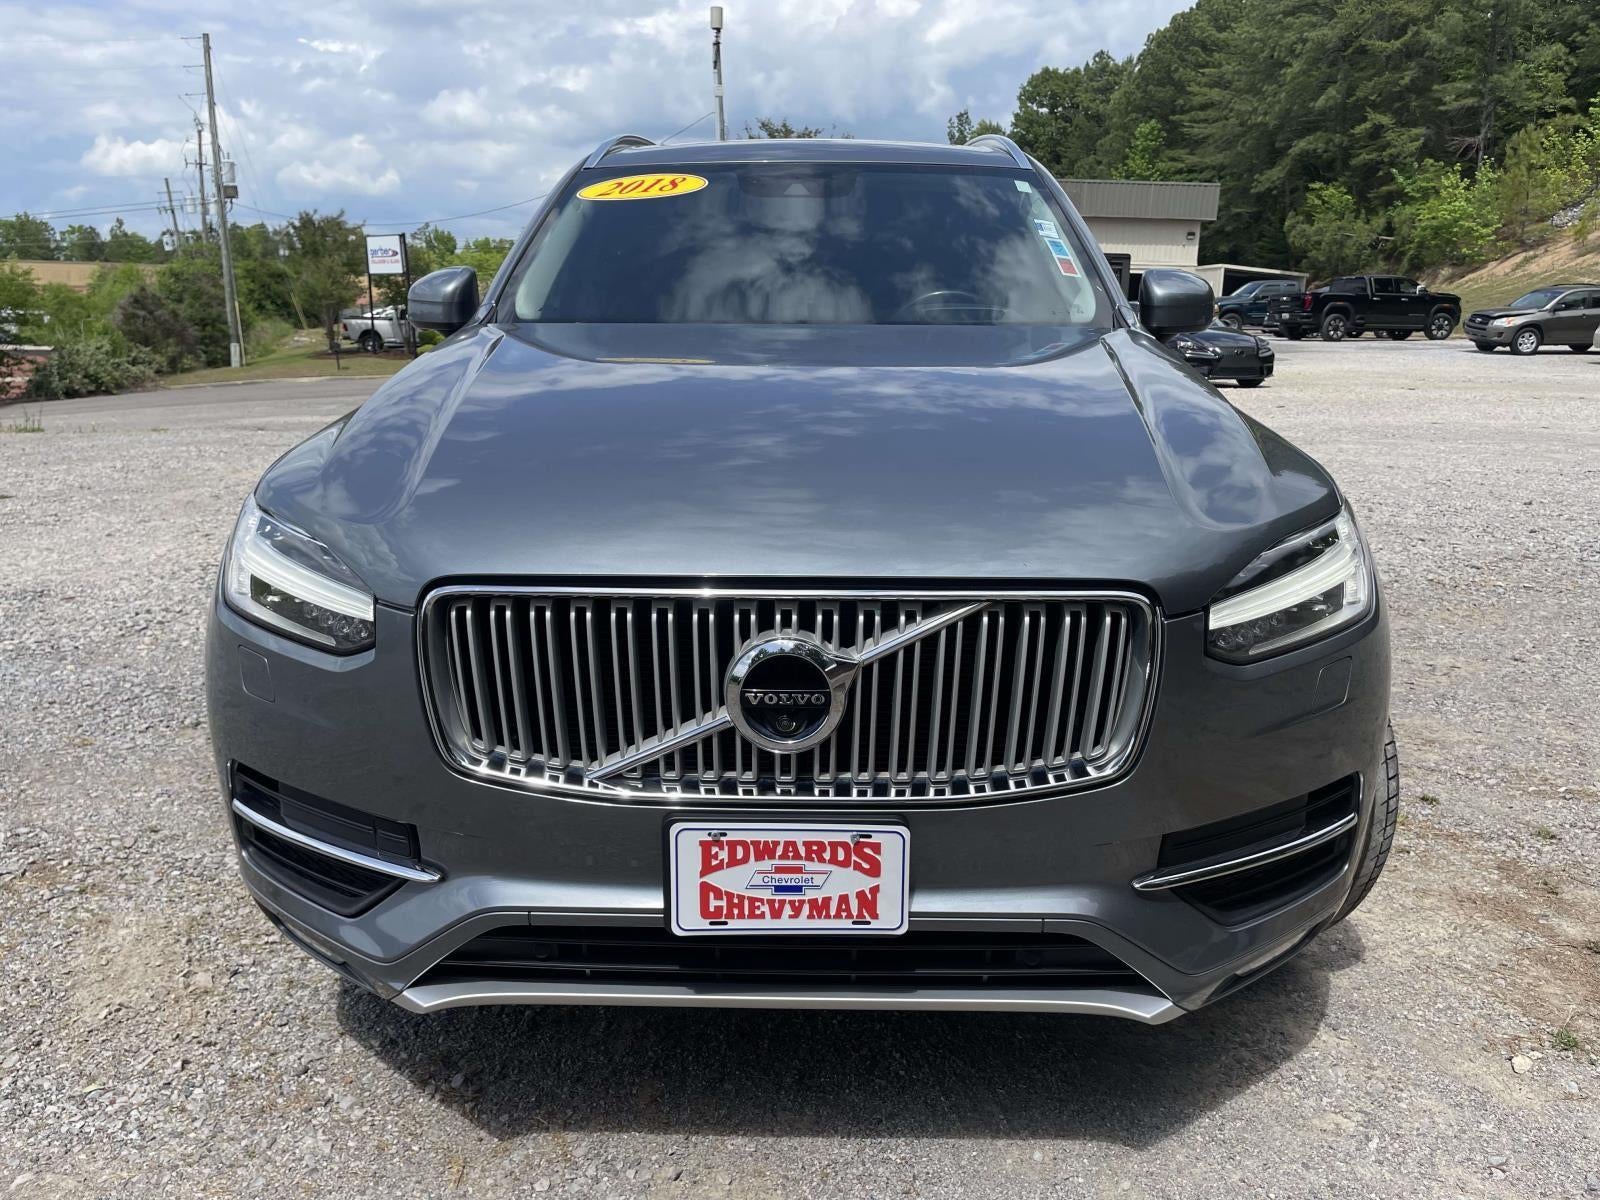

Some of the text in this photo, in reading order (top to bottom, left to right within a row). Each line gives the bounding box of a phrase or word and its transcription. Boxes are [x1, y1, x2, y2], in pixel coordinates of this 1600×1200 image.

[595, 177, 687, 197] 2018
[744, 693, 826, 705] VOLVO
[698, 839, 882, 878] EDWARDS
[761, 875, 815, 885] Chevrolet
[699, 880, 881, 920] CHEVYMAN
